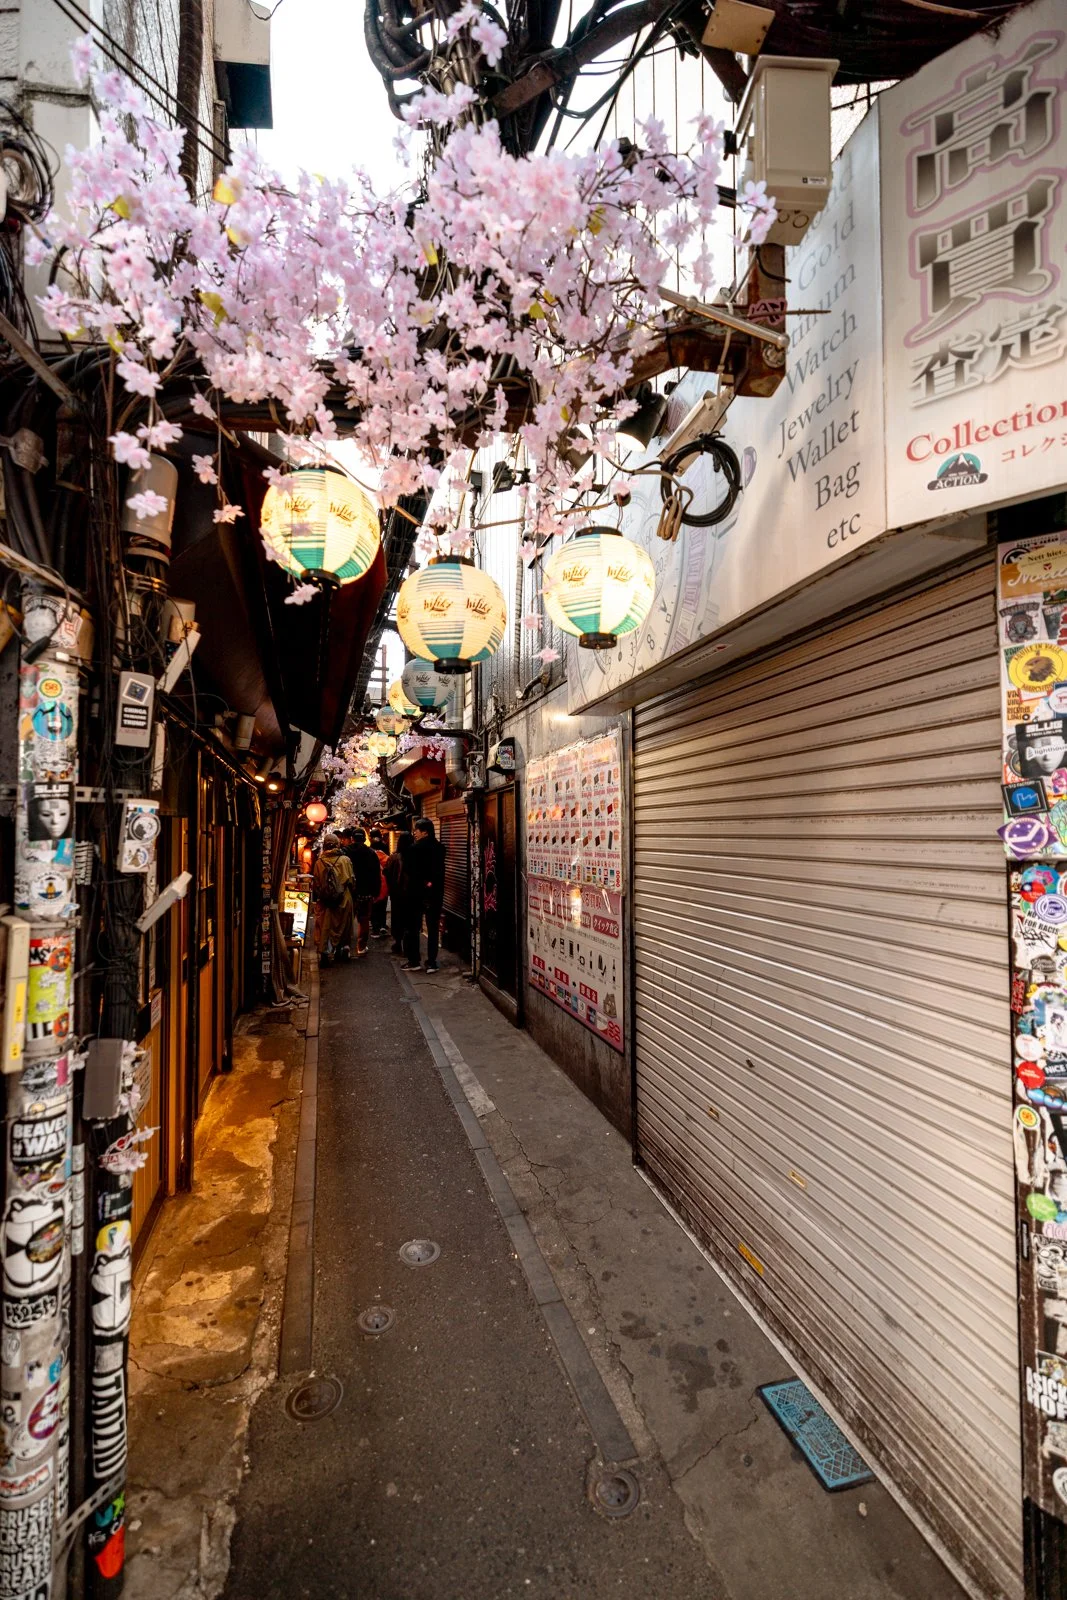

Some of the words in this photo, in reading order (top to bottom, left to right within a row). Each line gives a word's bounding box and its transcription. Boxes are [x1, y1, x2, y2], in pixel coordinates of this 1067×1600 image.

[798, 202, 856, 291] Gold
[786, 263, 856, 356] tinum
[784, 309, 858, 396] Watch
[778, 358, 860, 459] Jewelry
[786, 409, 860, 483] Wallet
[815, 461, 861, 511] Bag
[934, 474, 981, 489] ACTION
[827, 513, 861, 549] etc
[1024, 918, 1037, 928] FOR
[1045, 1064, 1065, 1074] NICE
[13, 1115, 67, 1139] BEAVE
[23, 1130, 67, 1157] WAX
